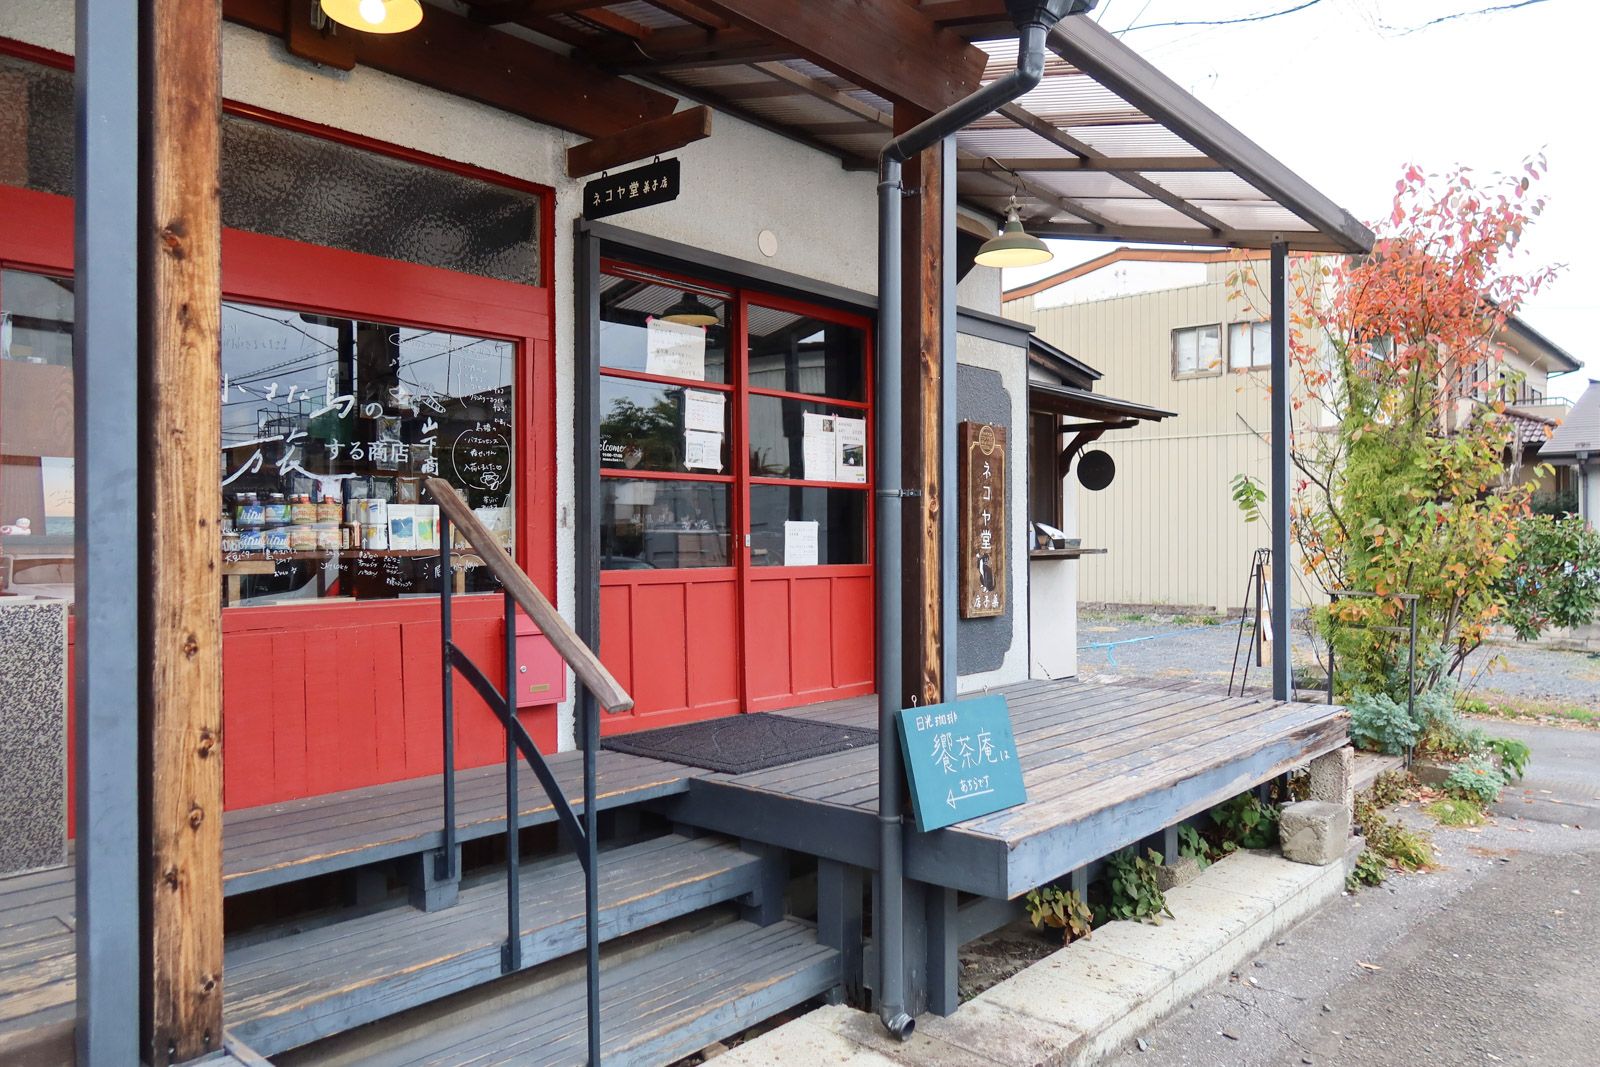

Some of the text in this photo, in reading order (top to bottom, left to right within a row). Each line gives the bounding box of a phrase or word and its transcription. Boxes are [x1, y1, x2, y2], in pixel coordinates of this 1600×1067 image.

[981, 461, 992, 550] ネコヤ堂
[915, 712, 958, 732] 日光珈琲
[960, 775, 990, 793] あちらです
